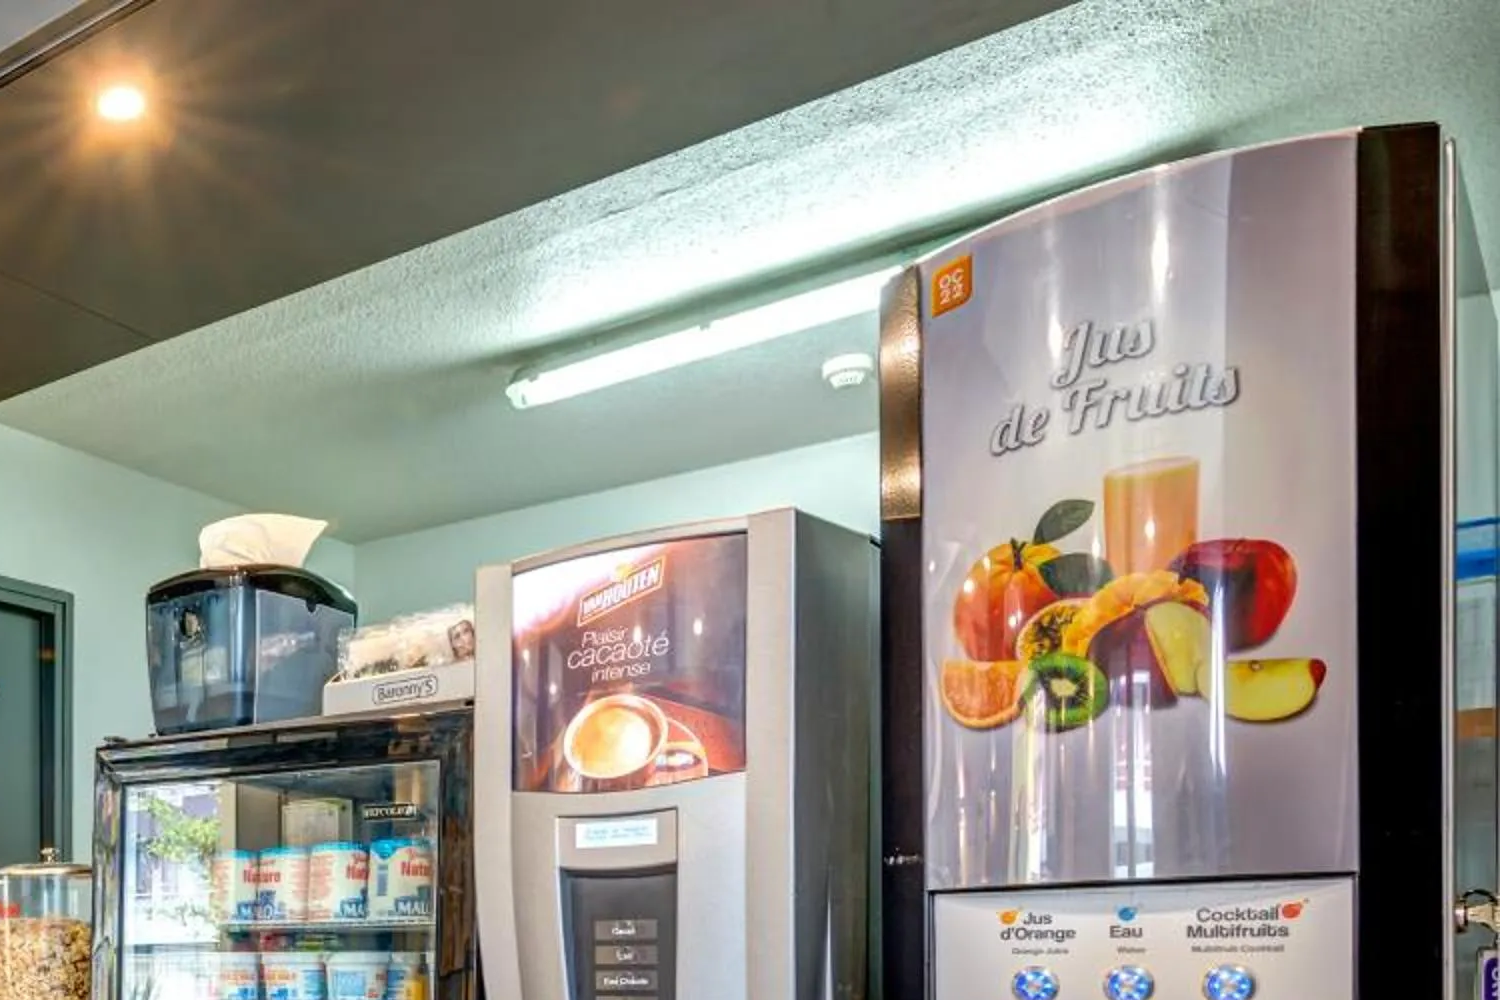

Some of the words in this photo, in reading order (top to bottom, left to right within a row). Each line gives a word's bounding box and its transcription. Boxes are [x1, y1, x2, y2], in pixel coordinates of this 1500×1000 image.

[1050, 320, 1156, 390] Jus
[989, 403, 1050, 457] de
[1062, 362, 1241, 436] Fruits
[581, 626, 629, 649] Plaisir
[567, 629, 670, 670] cacaoté
[590, 661, 652, 684] intense
[1022, 912, 1053, 926] Jus
[1195, 903, 1281, 923] Cocktail
[1000, 926, 1077, 943] d'Orange
[1109, 925, 1144, 939] Eau
[1186, 923, 1290, 939] Multifruits
